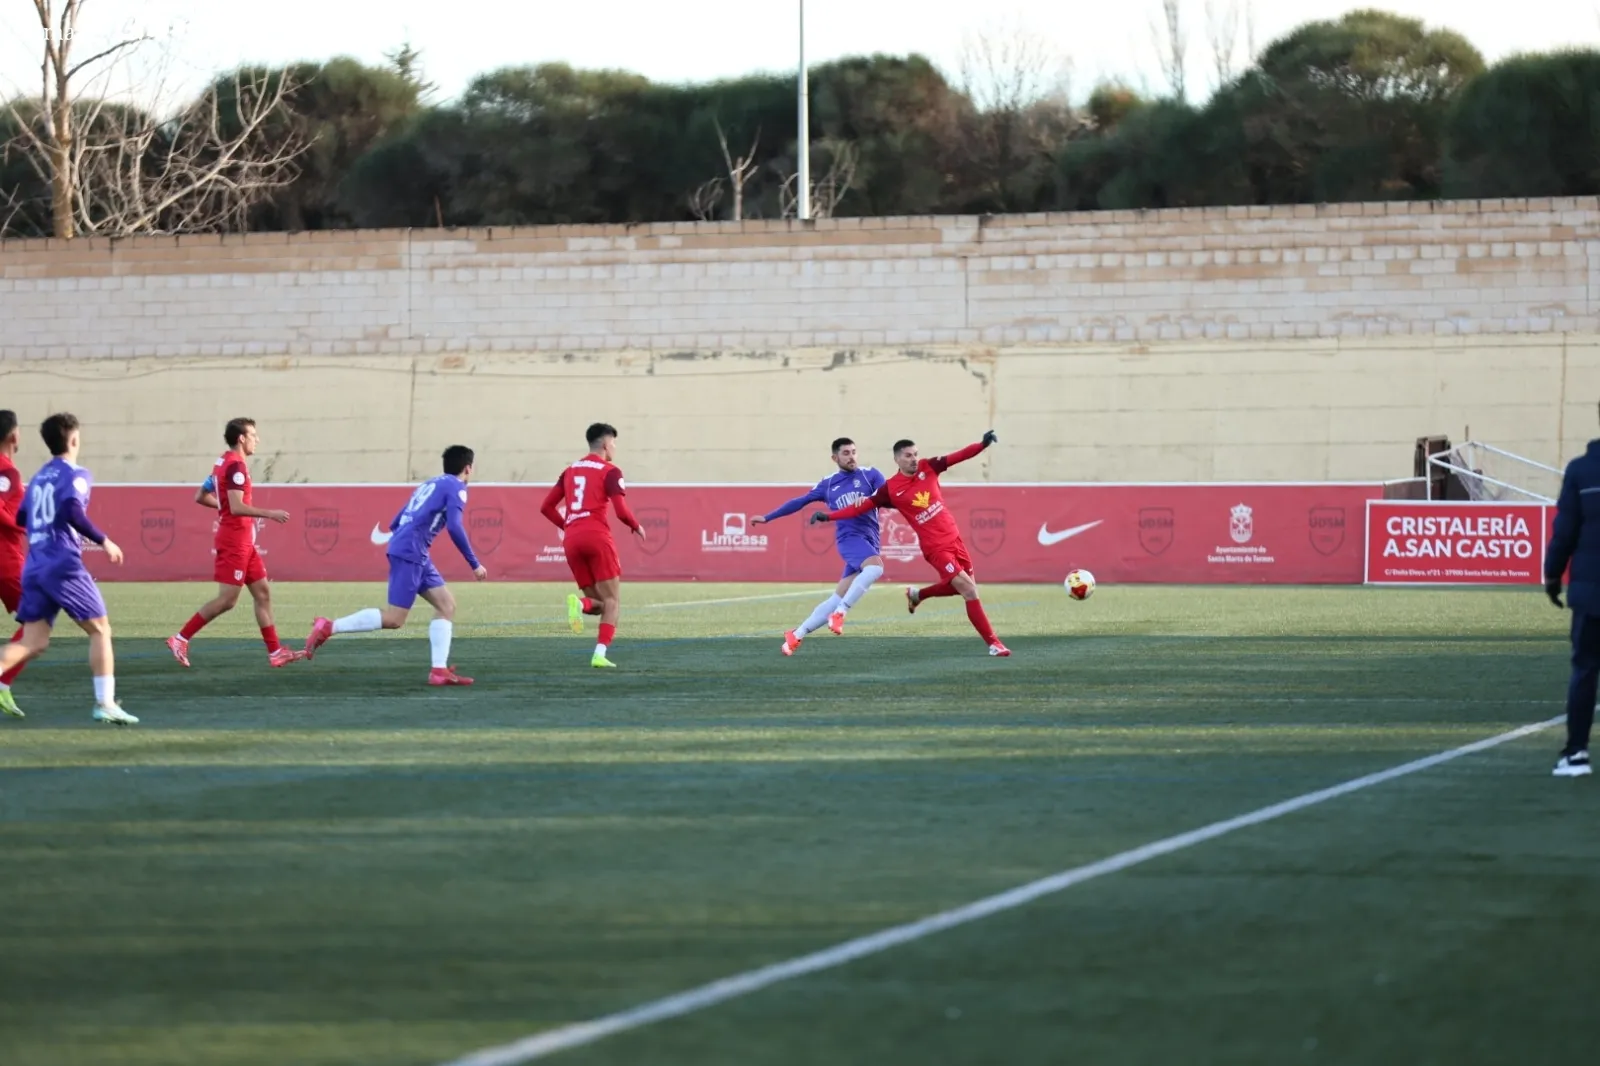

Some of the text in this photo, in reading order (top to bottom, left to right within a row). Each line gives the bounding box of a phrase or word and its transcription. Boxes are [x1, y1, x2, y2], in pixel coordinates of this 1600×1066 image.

[571, 475, 587, 511] 3
[32, 482, 55, 530] 20
[1386, 514, 1530, 536] CRISTALERÍA
[701, 529, 768, 545] Limcasa
[1383, 538, 1533, 559] A.SAN CASTO
